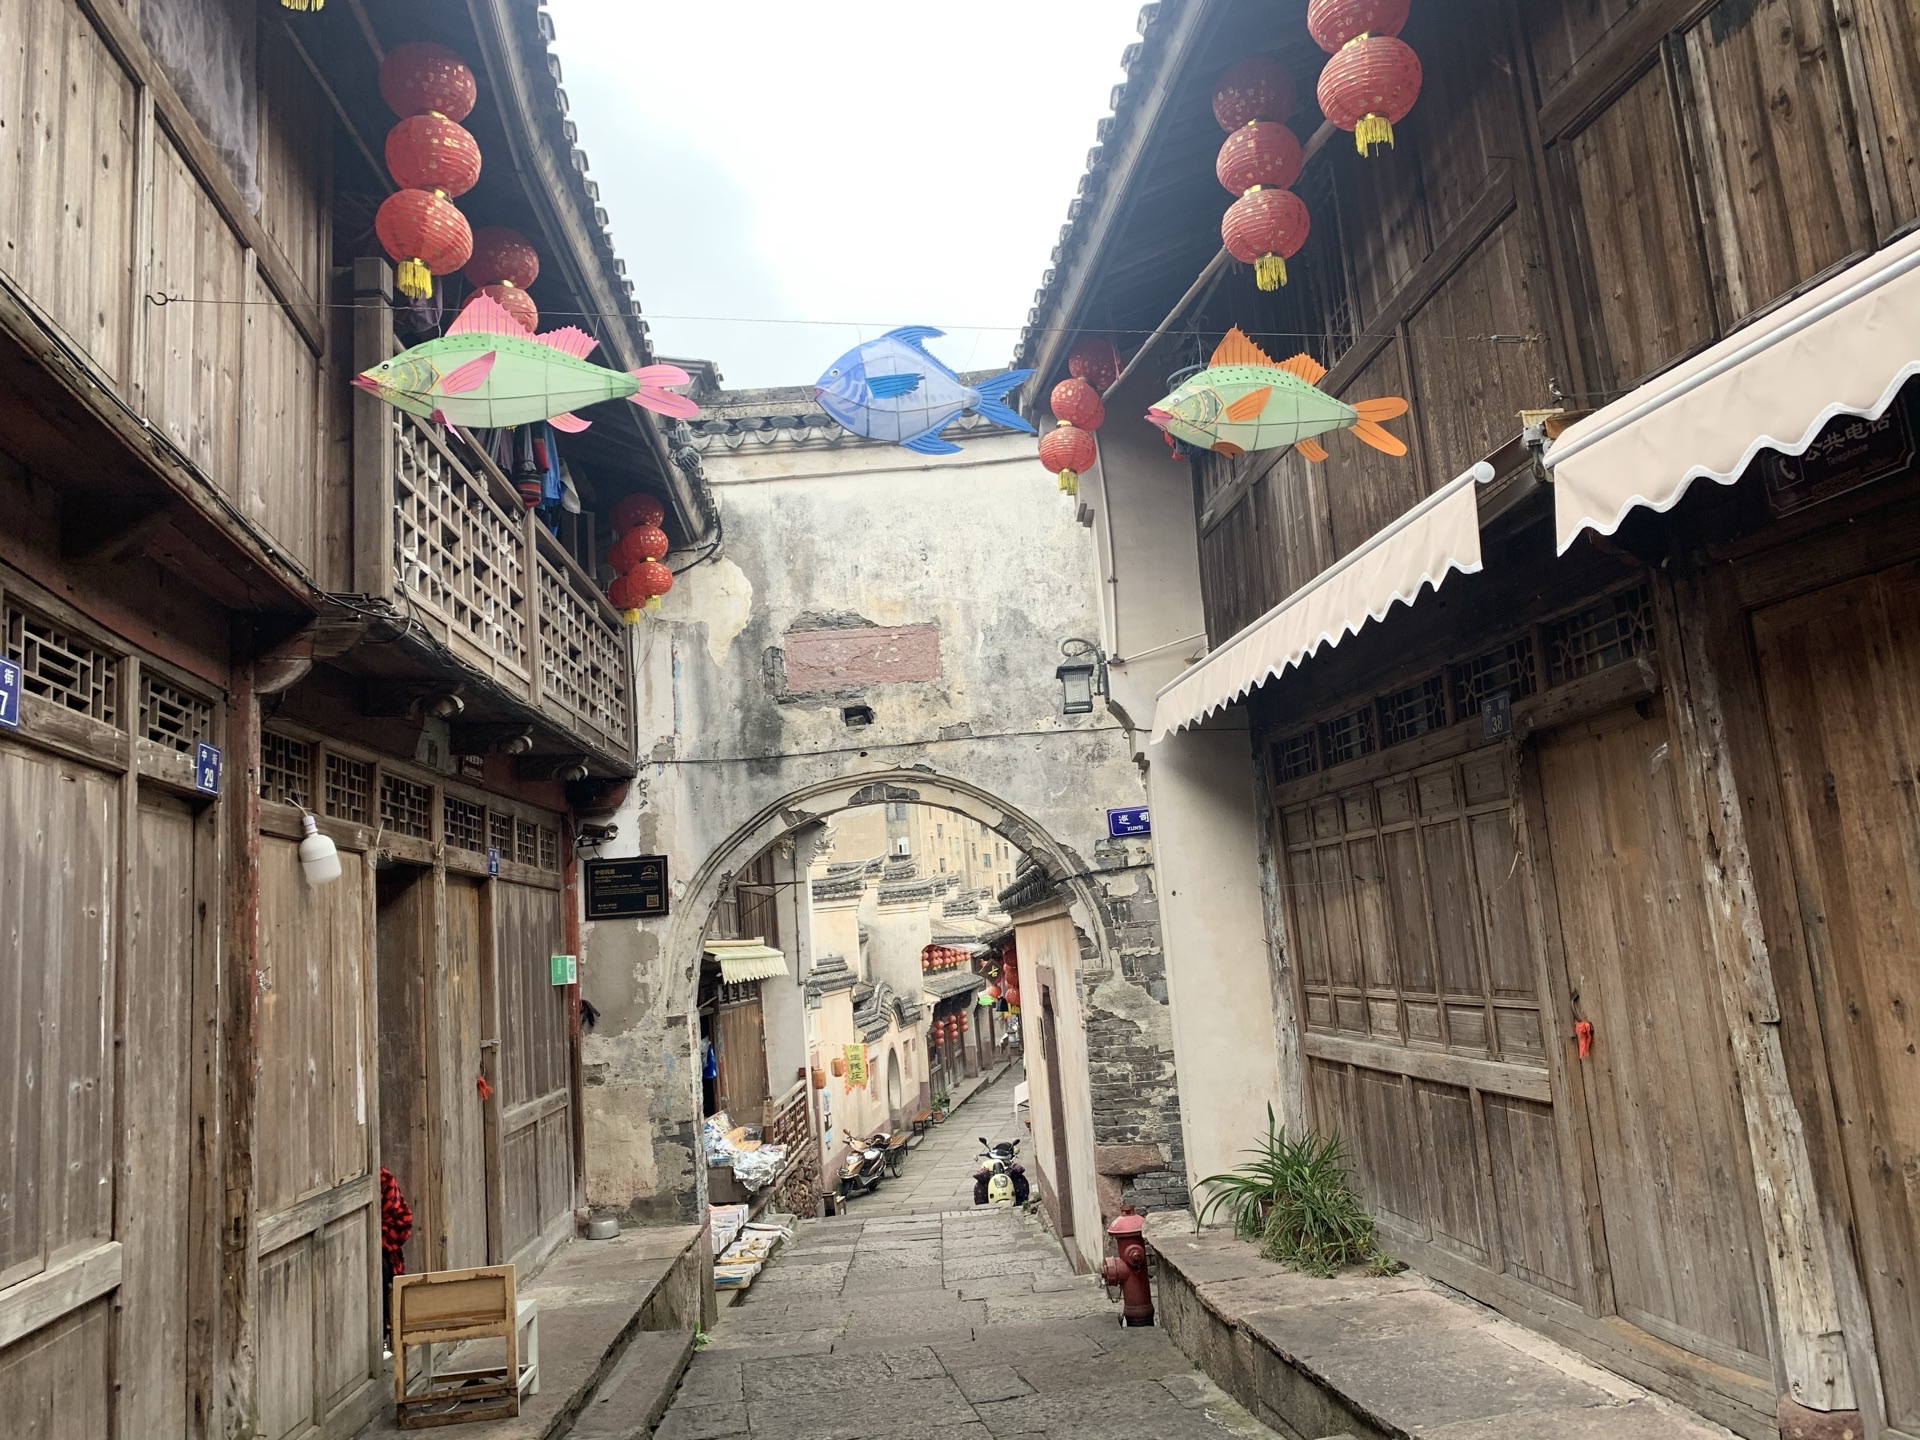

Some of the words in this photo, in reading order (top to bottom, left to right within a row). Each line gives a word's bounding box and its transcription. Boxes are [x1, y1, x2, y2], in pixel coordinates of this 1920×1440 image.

[1805, 413, 1892, 461] 公共电话
[1827, 443, 1869, 466] Telephone
[1492, 714, 1503, 733] 38
[204, 767, 214, 788] 29
[1118, 811, 1149, 825] 巡司
[1126, 824, 1144, 832] XUNSI
